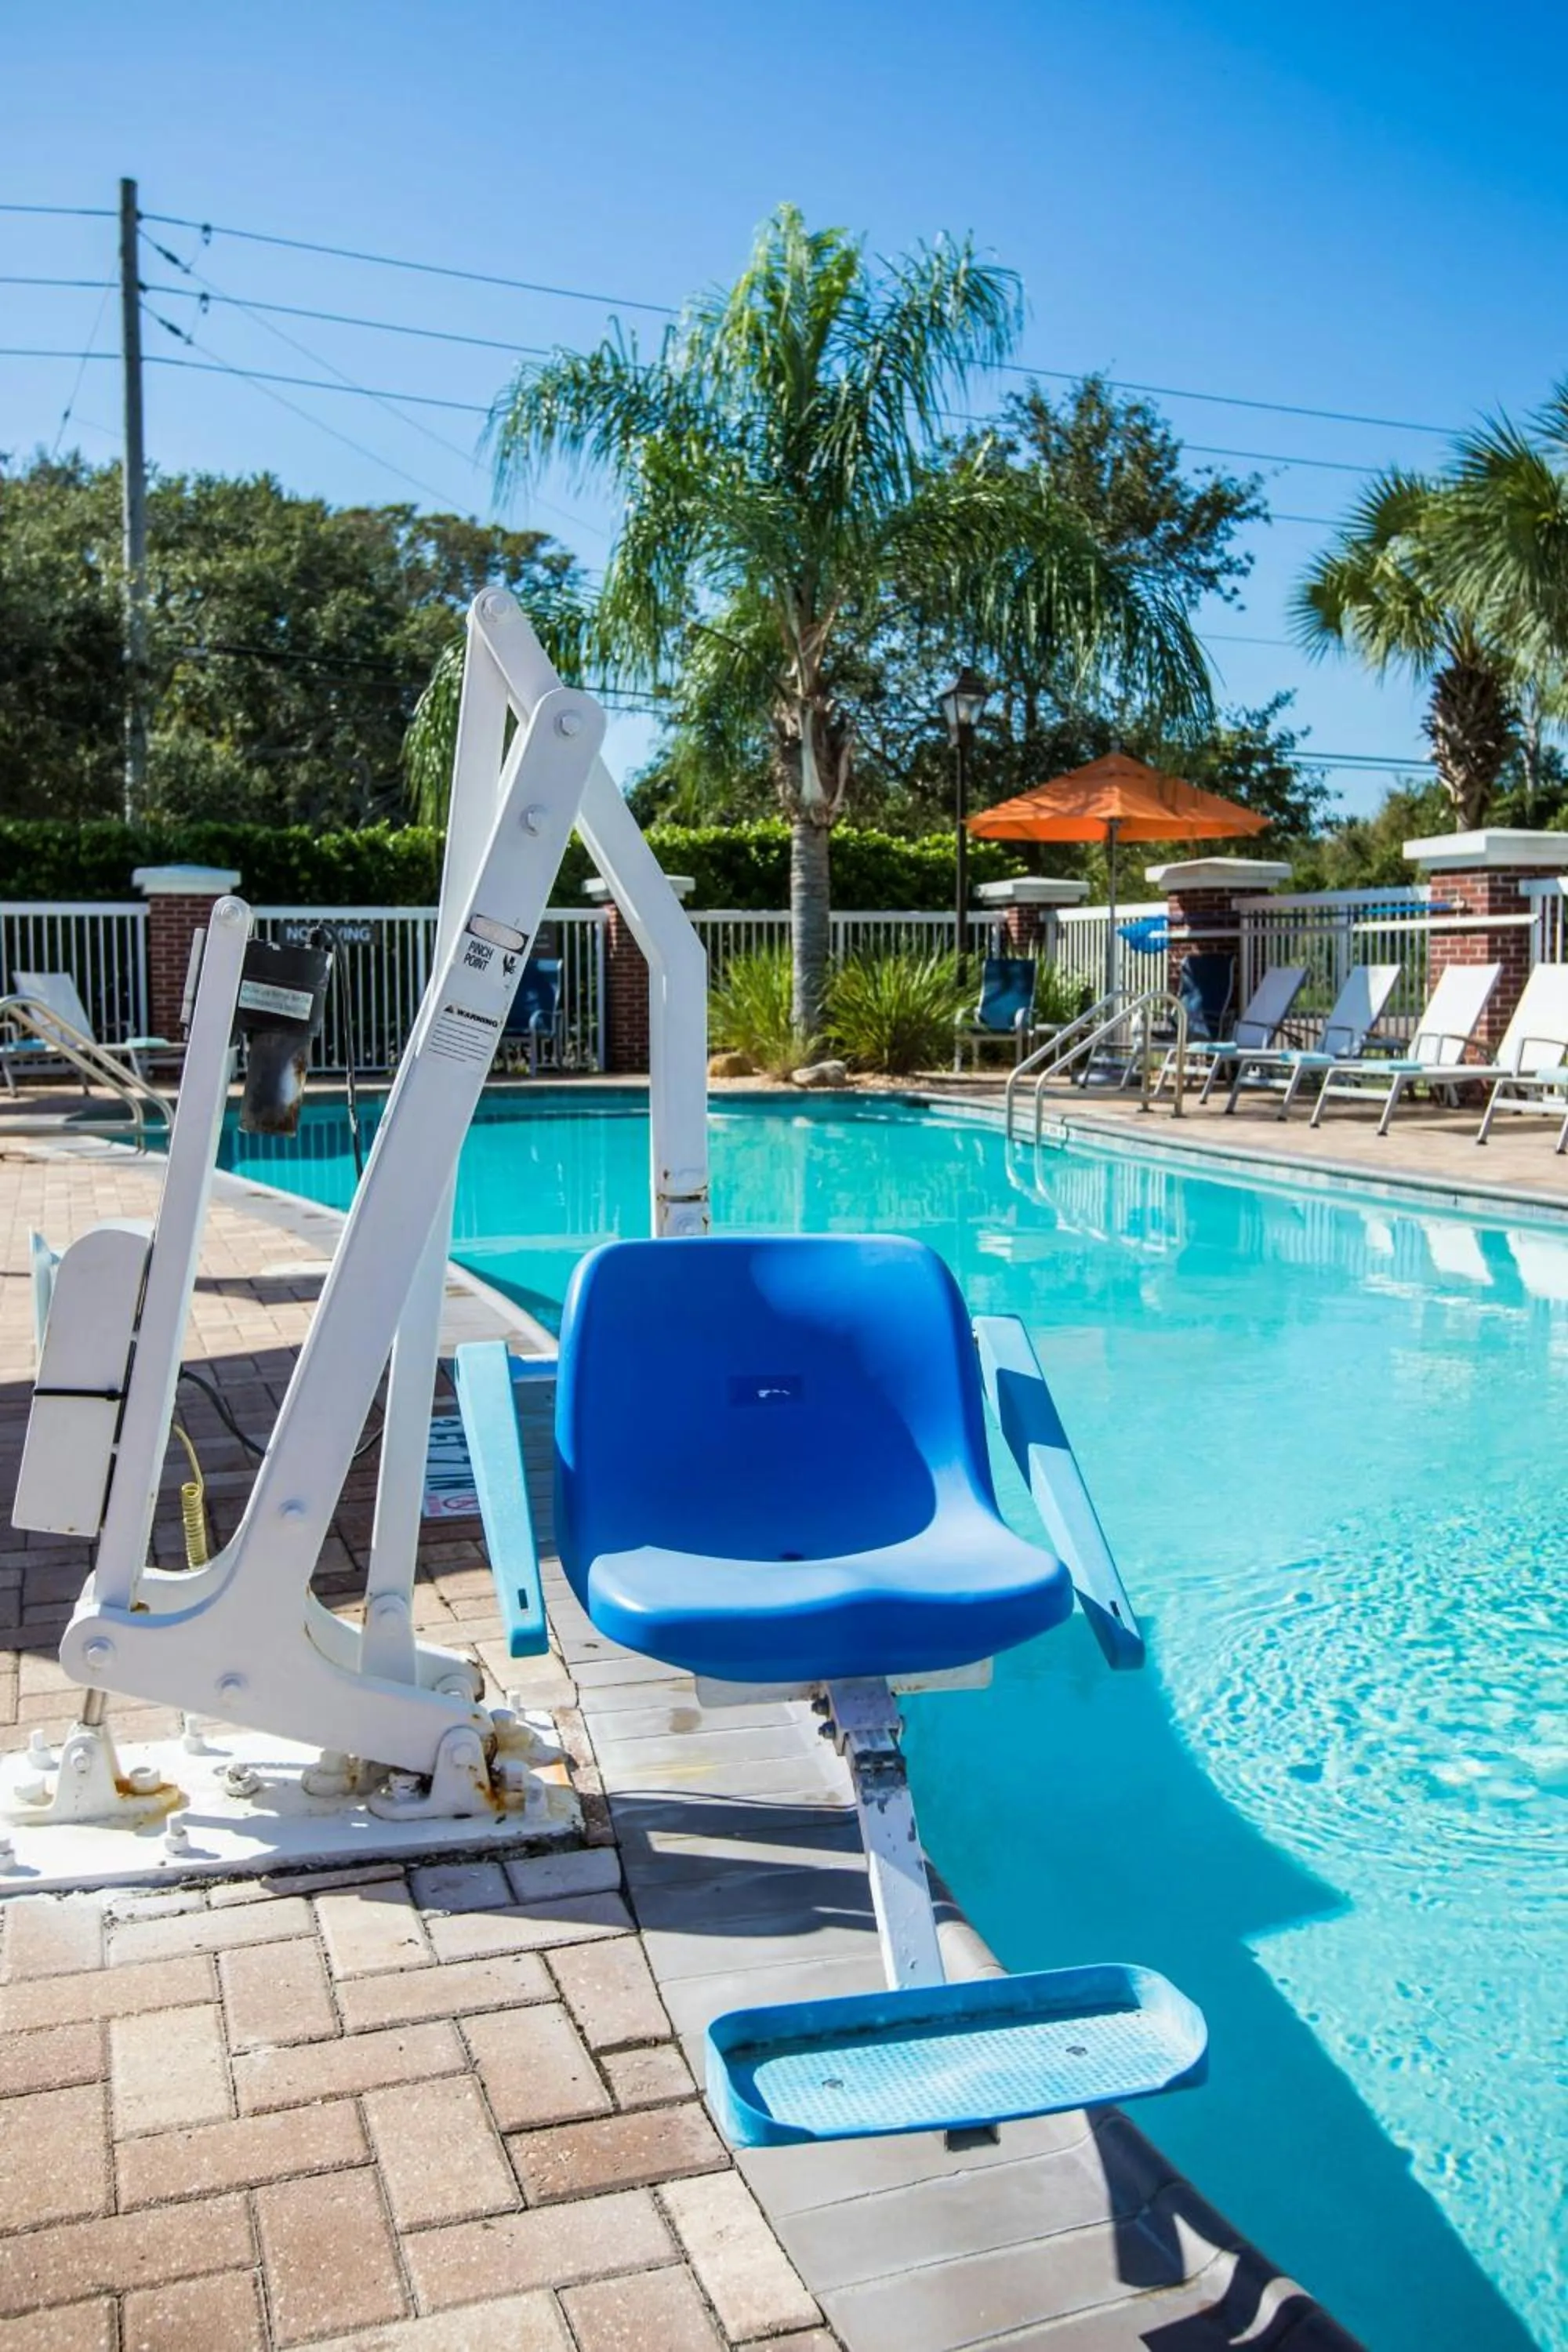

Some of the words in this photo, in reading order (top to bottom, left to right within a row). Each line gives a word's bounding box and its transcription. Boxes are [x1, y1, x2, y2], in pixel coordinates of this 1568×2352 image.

[286, 926, 311, 941] NO
[468, 940, 495, 960] PINCH
[464, 952, 489, 971] POINT
[456, 1008, 498, 1028] WARNING
